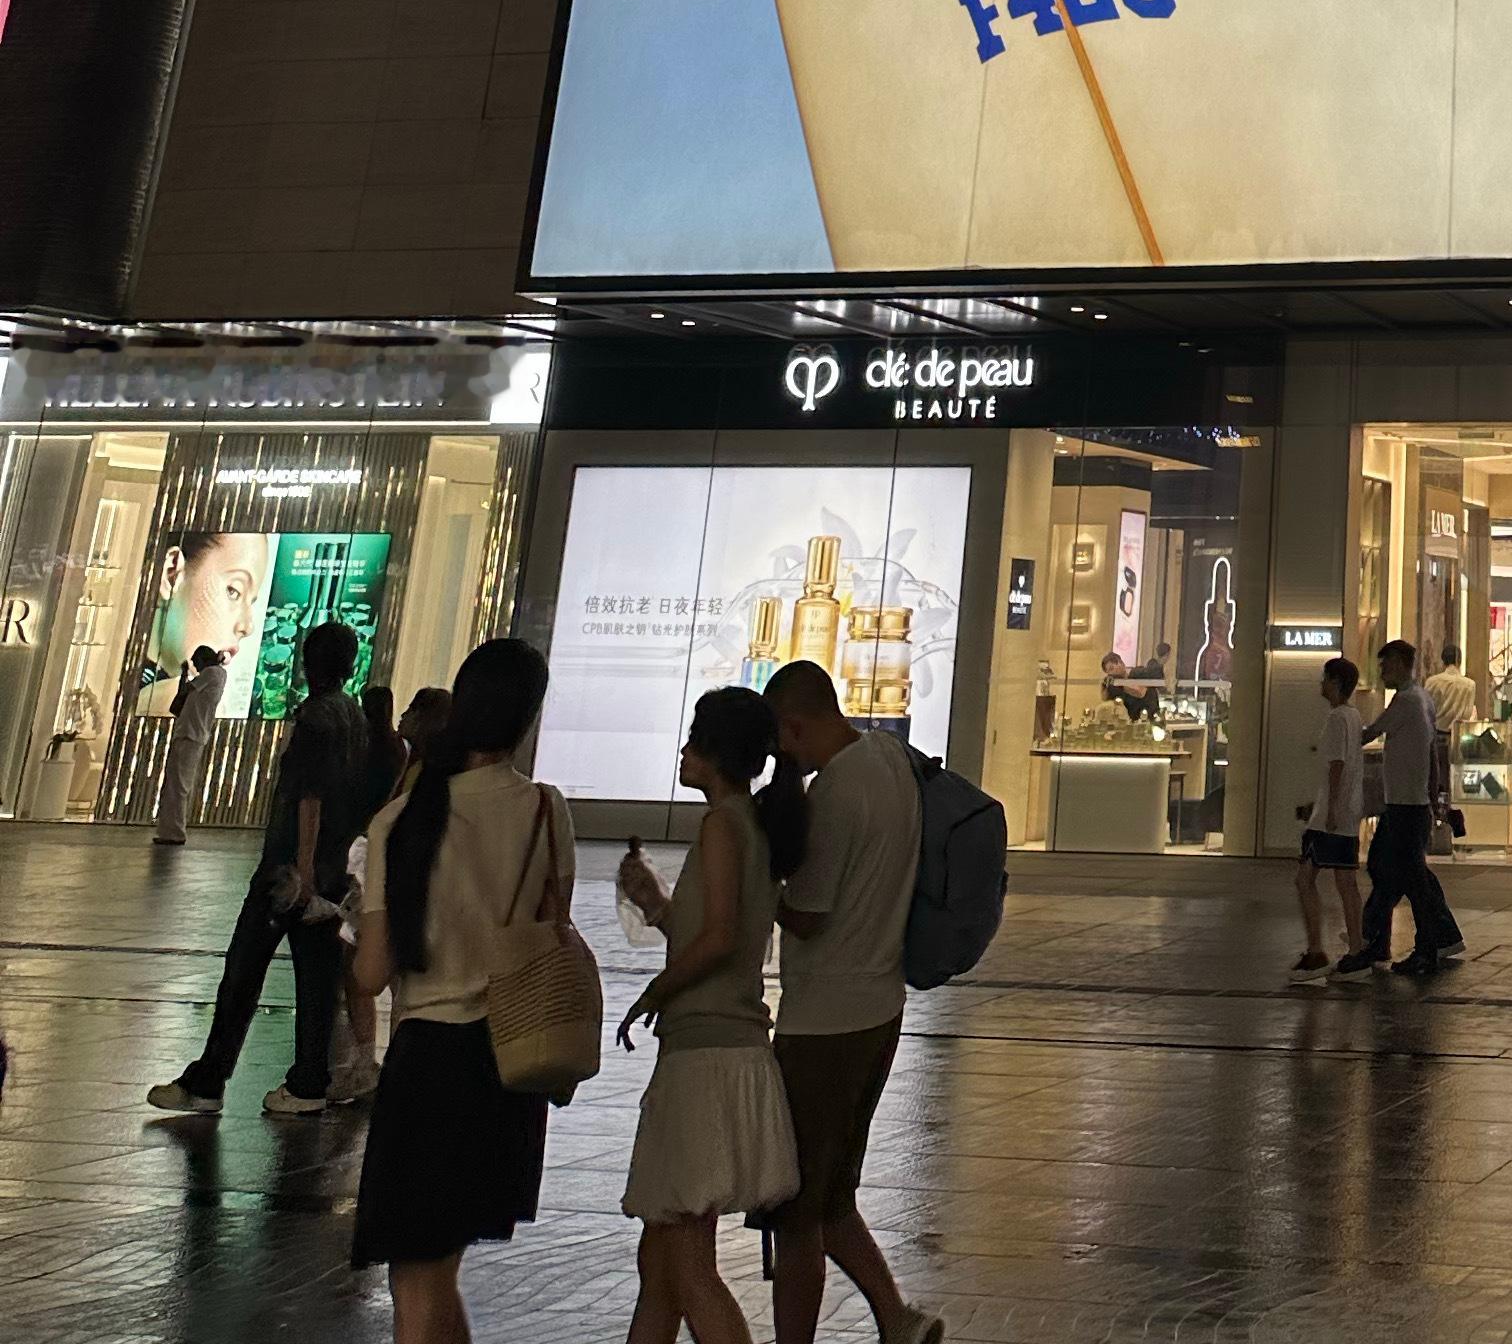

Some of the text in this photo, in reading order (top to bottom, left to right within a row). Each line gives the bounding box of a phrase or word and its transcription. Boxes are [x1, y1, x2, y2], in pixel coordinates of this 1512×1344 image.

[914, 349, 955, 388] de
[959, 358, 1034, 398] peau
[895, 395, 997, 419] BEAUTÉ
[584, 595, 723, 616] 倍效抗老 日夜年轻
[1285, 631, 1333, 646] LA MER
